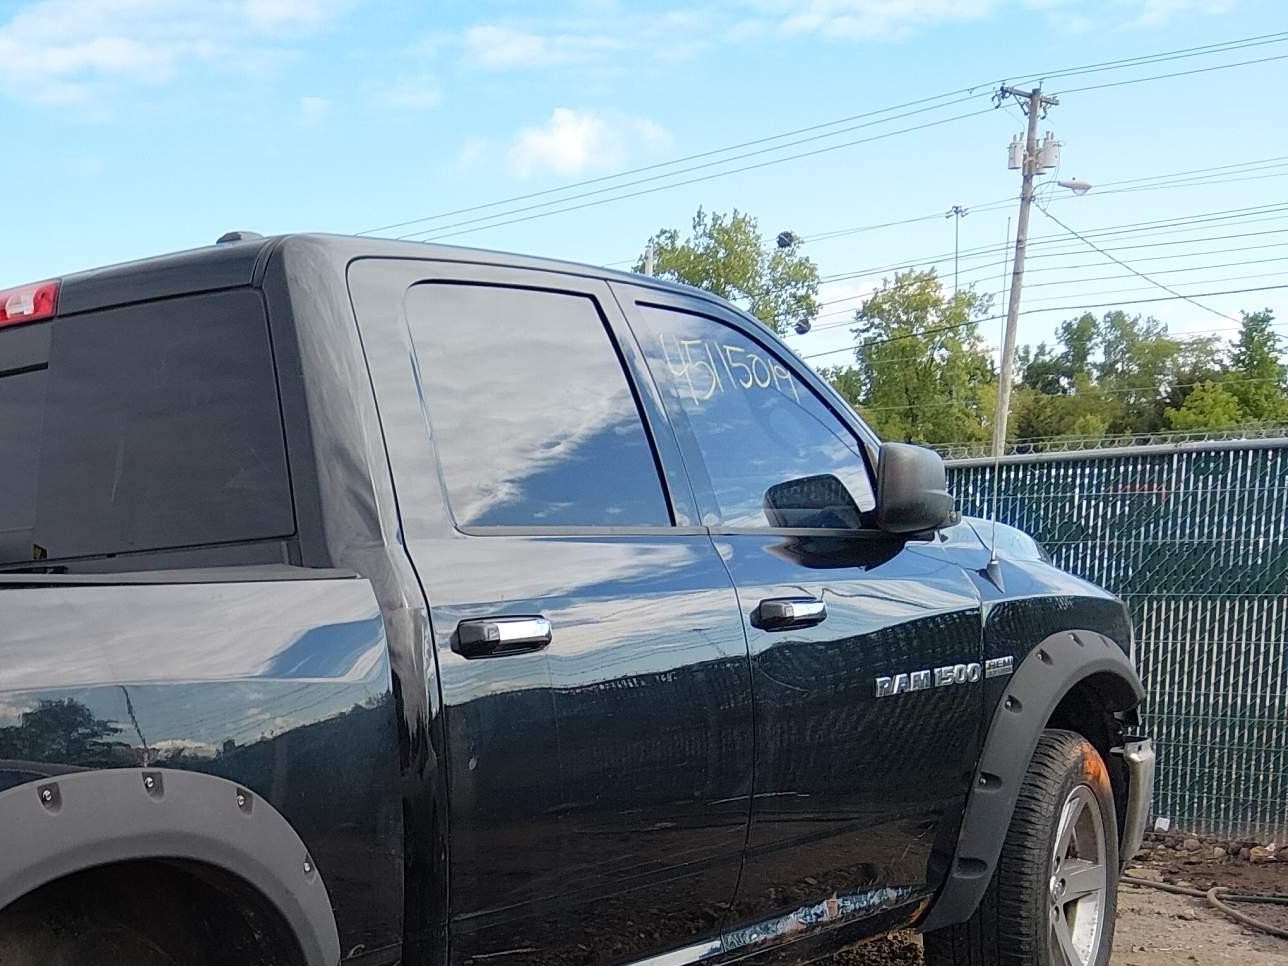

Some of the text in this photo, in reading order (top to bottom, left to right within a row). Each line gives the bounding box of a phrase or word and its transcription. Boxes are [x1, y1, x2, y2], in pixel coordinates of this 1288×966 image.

[659, 334, 801, 405] 45115019
[875, 669, 931, 698] RAM
[933, 662, 982, 688] 1500
